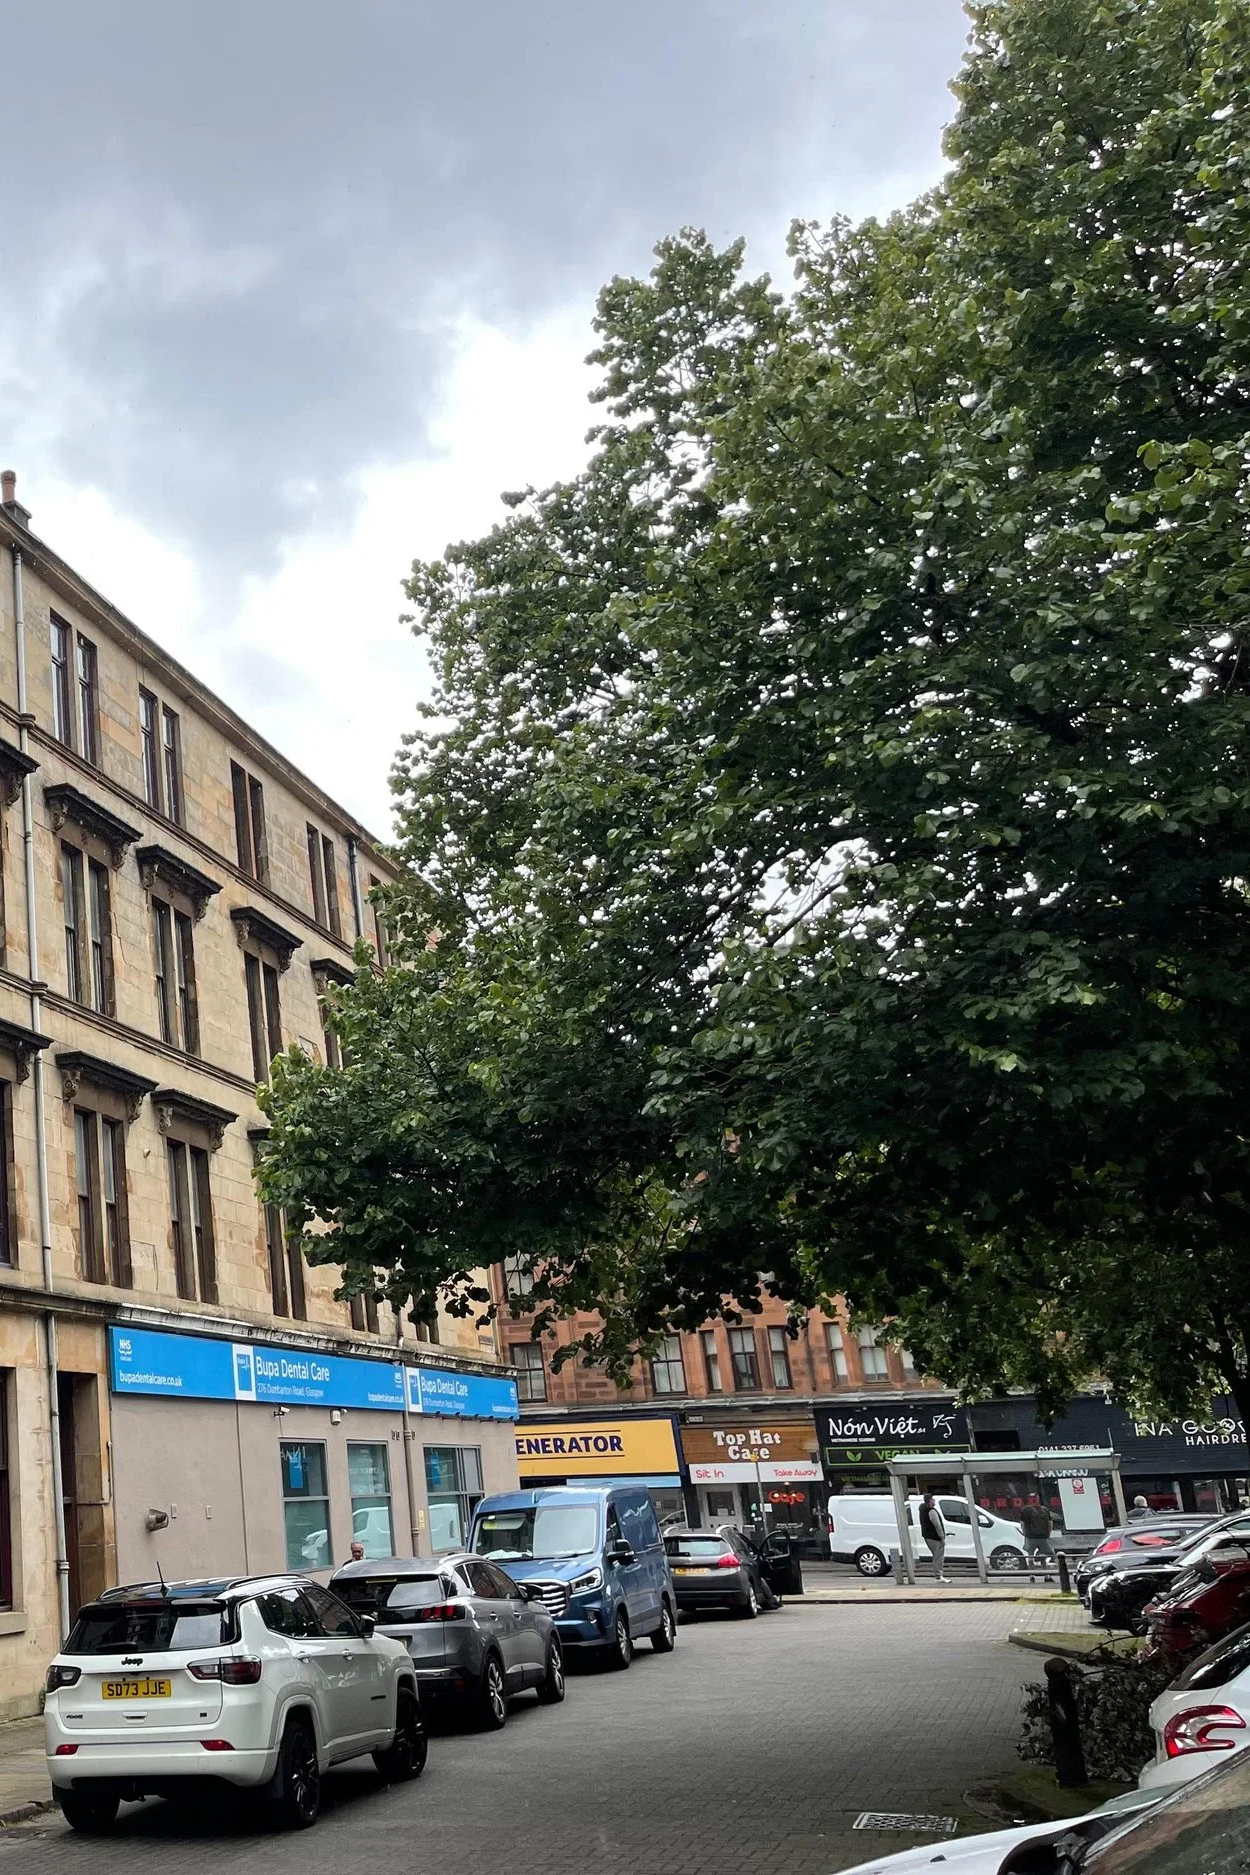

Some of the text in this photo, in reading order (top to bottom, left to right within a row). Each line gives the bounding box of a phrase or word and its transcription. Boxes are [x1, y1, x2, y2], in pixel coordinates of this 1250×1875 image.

[119, 1339, 131, 1350] NHS
[256, 1356, 330, 1382] Bupa Dental Care
[119, 1370, 183, 1387] bupadentalcare.co.uk
[421, 1376, 437, 1395] Bupa
[437, 1379, 455, 1396] Dental
[456, 1382, 469, 1397] Care
[515, 1435, 624, 1455] ENERATOR
[749, 1429, 781, 1445] Hat
[1185, 1433, 1247, 1446] HAIRDRE
[695, 1469, 724, 1478] Sit In
[773, 1469, 818, 1477] Take Away
[121, 1657, 144, 1666] Jeep
[107, 1681, 166, 1697] SD73 JJE
